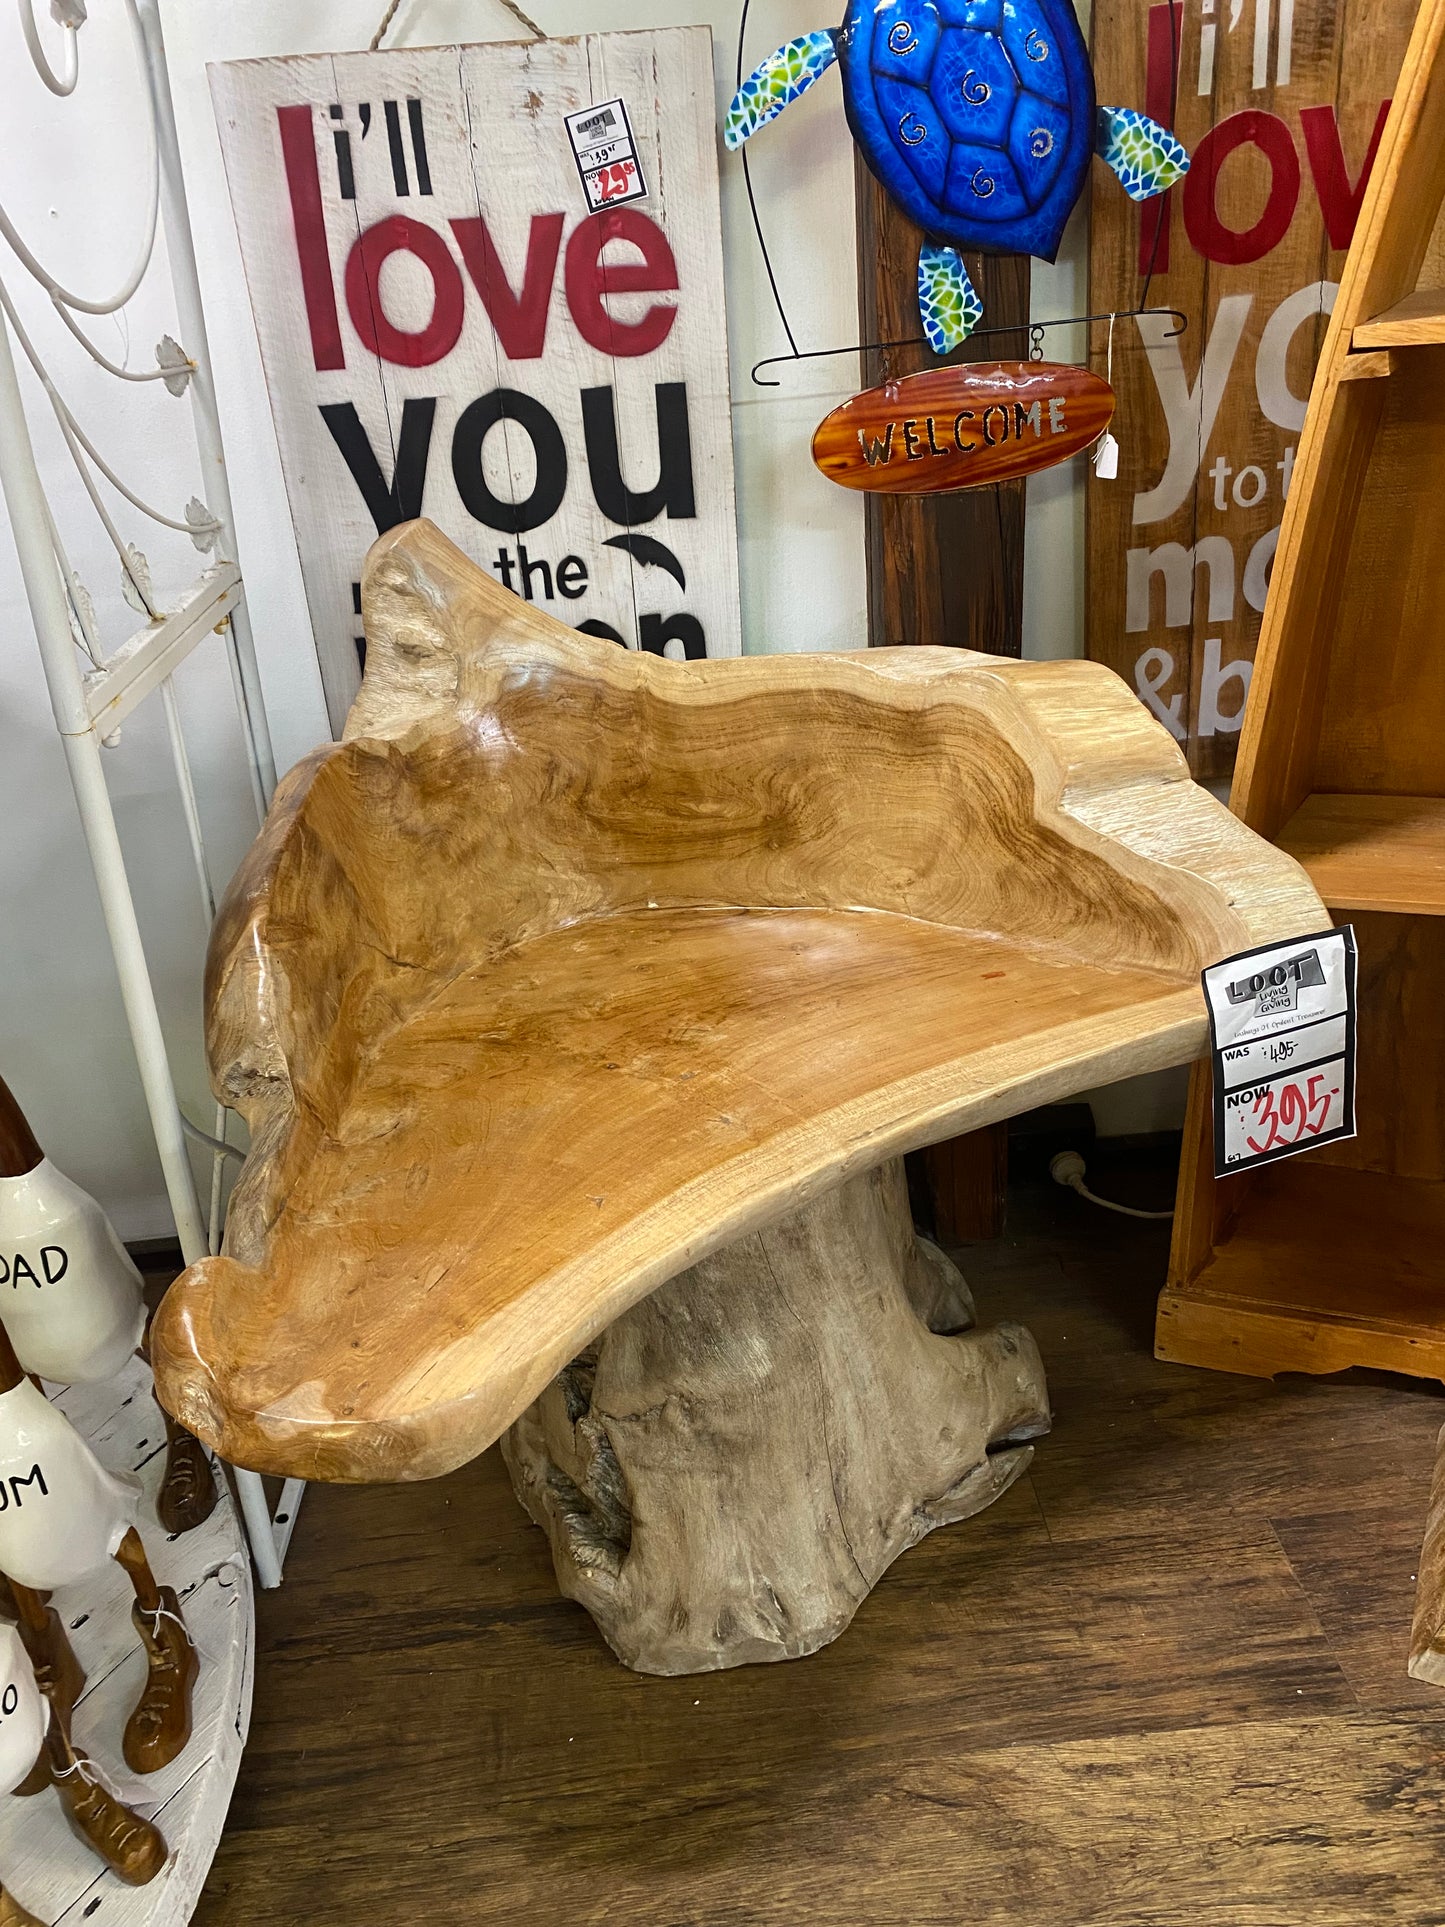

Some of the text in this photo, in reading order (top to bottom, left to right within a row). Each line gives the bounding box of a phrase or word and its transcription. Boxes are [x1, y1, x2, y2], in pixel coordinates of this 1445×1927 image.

[329, 99, 433, 199] i'll
[276, 104, 680, 371] love
[857, 396, 1067, 467] WELCOME
[317, 381, 697, 613] you
[493, 545, 588, 600] the
[1229, 954, 1314, 998] LOOT
[1224, 1047, 1250, 1061] WAS
[1227, 1084, 1271, 1109] NOW
